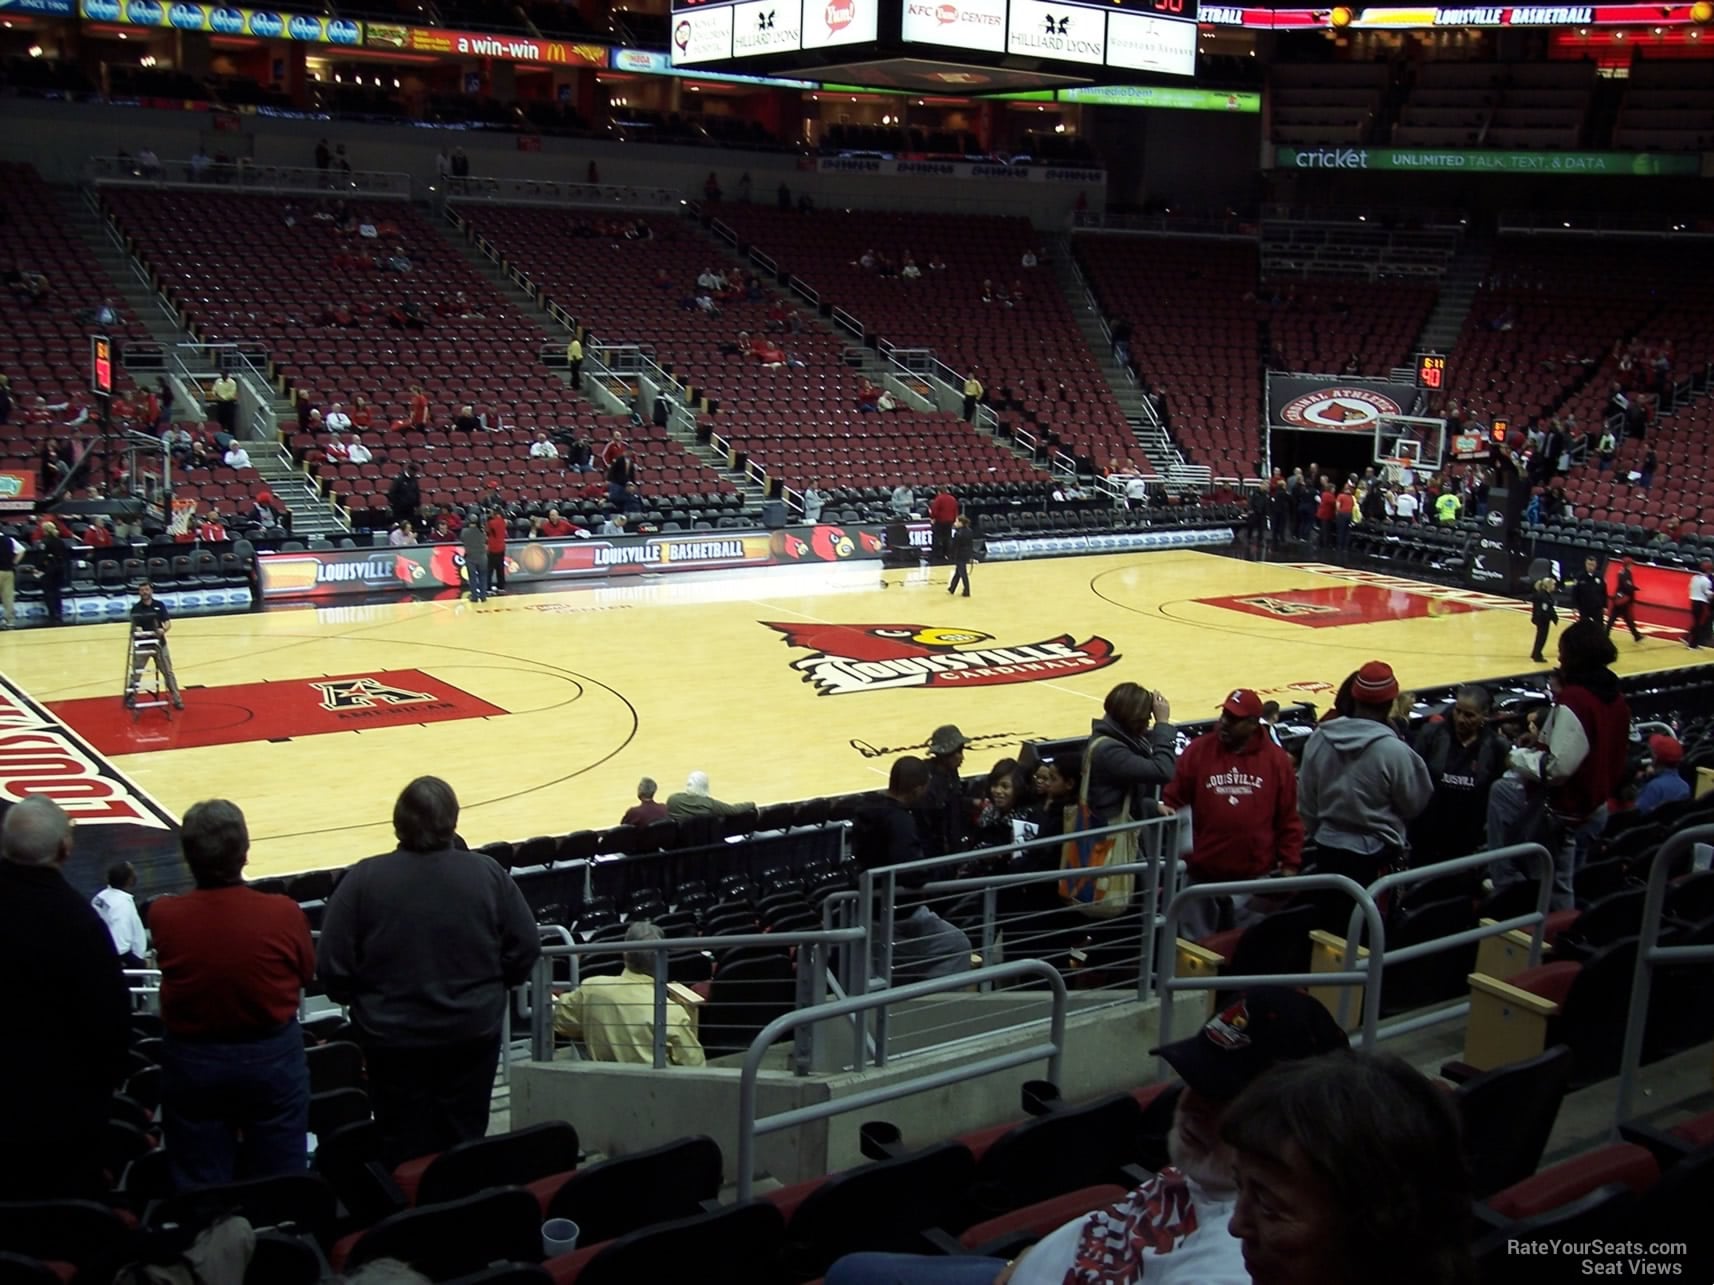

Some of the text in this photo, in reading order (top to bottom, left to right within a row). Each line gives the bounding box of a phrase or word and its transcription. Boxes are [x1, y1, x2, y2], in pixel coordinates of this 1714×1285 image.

[825, 5, 855, 24] Yum!
[908, 3, 934, 17] KFC
[961, 11, 1002, 26] CENTER
[1434, 7, 1593, 25] LOUISVILLE BASKETBALL
[458, 36, 469, 53] a
[470, 37, 540, 60] win-win
[1011, 32, 1102, 56] HILLIARD LYONS
[1295, 148, 1369, 169] cricket
[1392, 153, 1465, 167] UNLIMITED
[1551, 158, 1562, 169] &
[1565, 157, 1606, 169] DATA
[594, 540, 744, 565] LOUISVILLE BASKETBALL
[317, 560, 393, 583] LOUISVILLE
[797, 643, 1090, 695] LOUISVILLE
[939, 656, 1098, 681] CARDINALS
[338, 702, 456, 720] AMERICAN
[1205, 772, 1264, 789] LOUISVILLE
